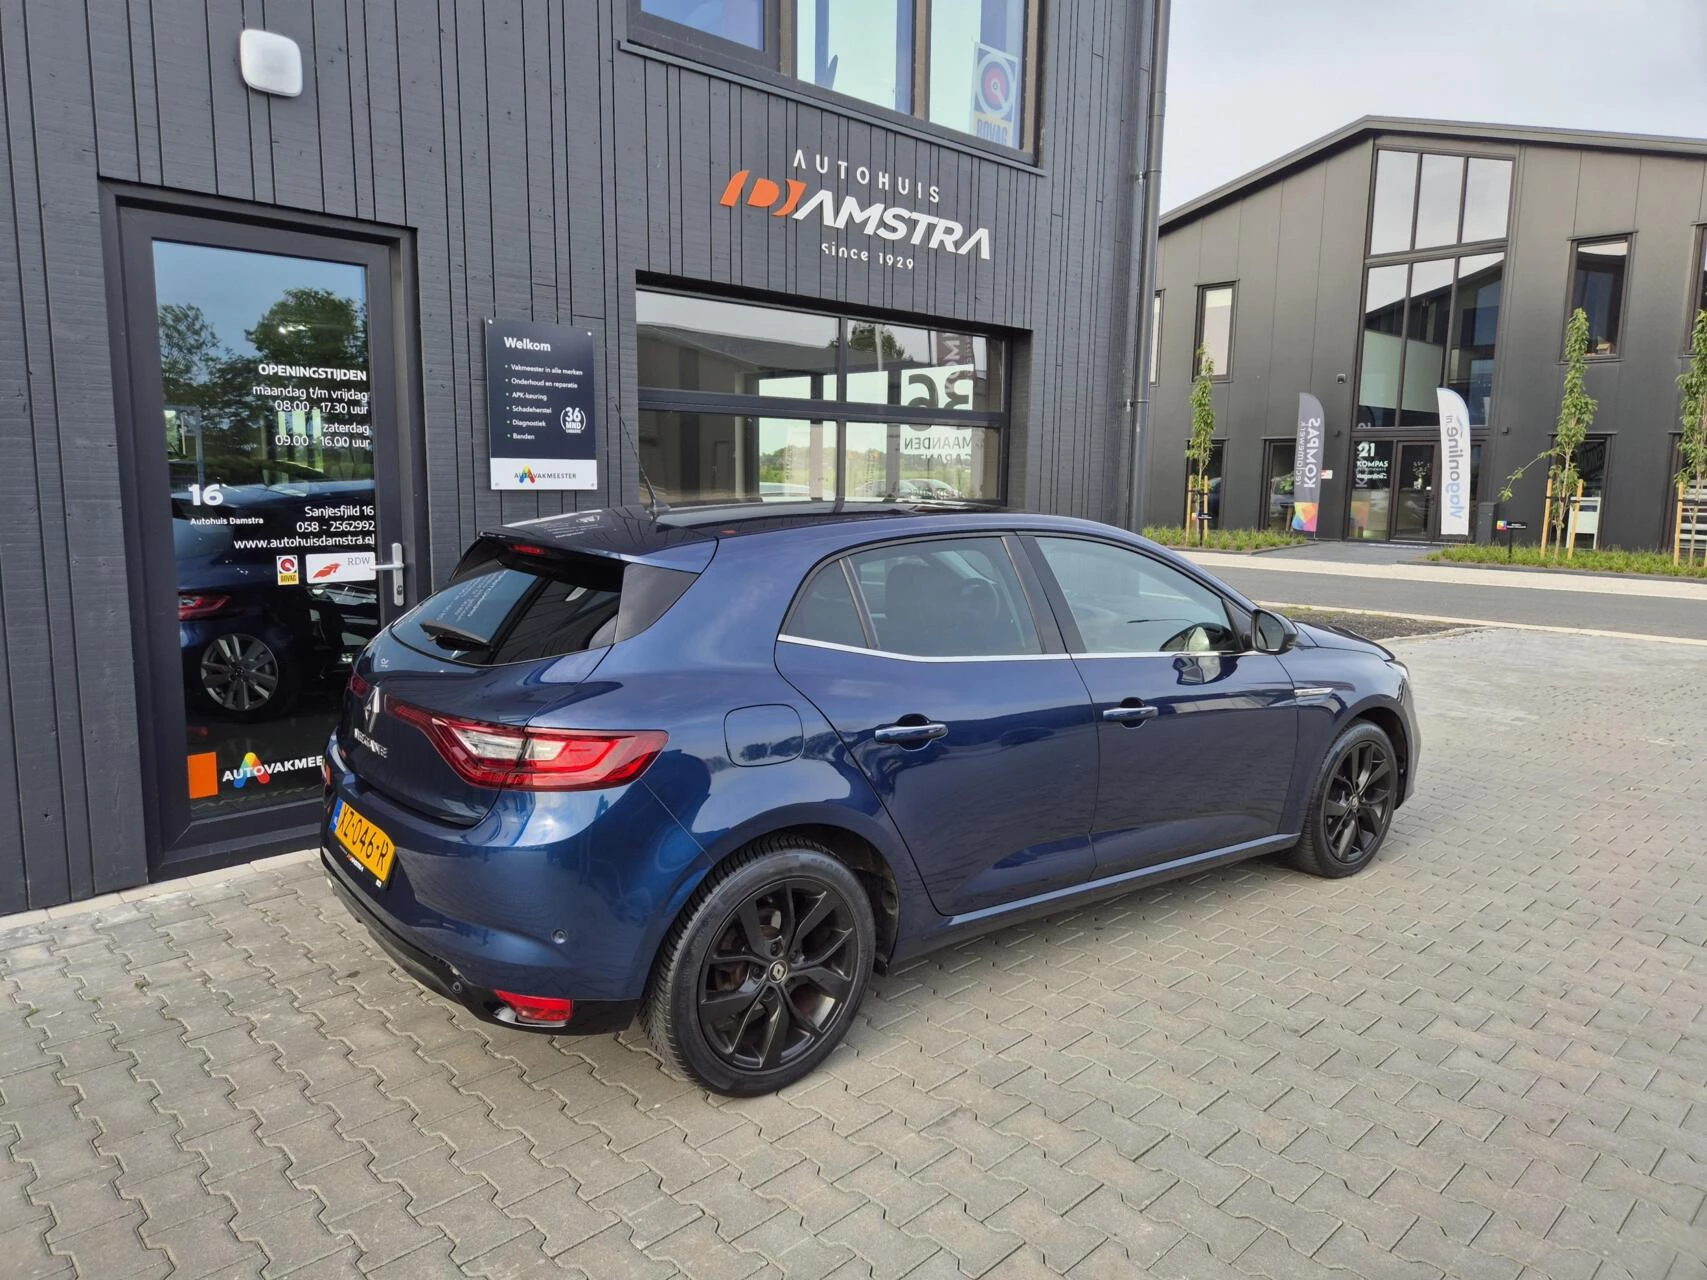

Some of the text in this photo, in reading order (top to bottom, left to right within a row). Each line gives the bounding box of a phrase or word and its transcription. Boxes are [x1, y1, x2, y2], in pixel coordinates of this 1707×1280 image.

[793, 149, 940, 203] AUTOHUIS
[821, 242, 914, 270] since 1929
[504, 336, 551, 352] Welkom
[258, 364, 367, 381] OPENINGSTIJDEN
[511, 364, 544, 372] Vakmeester
[511, 378, 545, 386] Onderhoud
[252, 385, 368, 403] maandag t/m vrijdag
[512, 392, 547, 401] APK-keuring
[320, 402, 348, 414] 17.30
[350, 405, 369, 414] uur
[512, 405, 552, 414] Schadeherstel
[565, 407, 581, 422] 36
[323, 422, 370, 436] zaterdag
[512, 419, 546, 427] Diagnostiek
[275, 435, 309, 446] 09.00
[320, 436, 350, 447] 16.00
[352, 439, 371, 448] uur
[1357, 442, 1376, 457] 21
[188, 483, 224, 506] 16
[304, 505, 375, 519] Sanjesfjild 16
[190, 517, 264, 525] Autohuis Damstra
[296, 521, 319, 533] 058
[330, 520, 375, 532] 2562992
[234, 534, 375, 549] www.autohuisdamstra.nl
[347, 556, 371, 566] RDW
